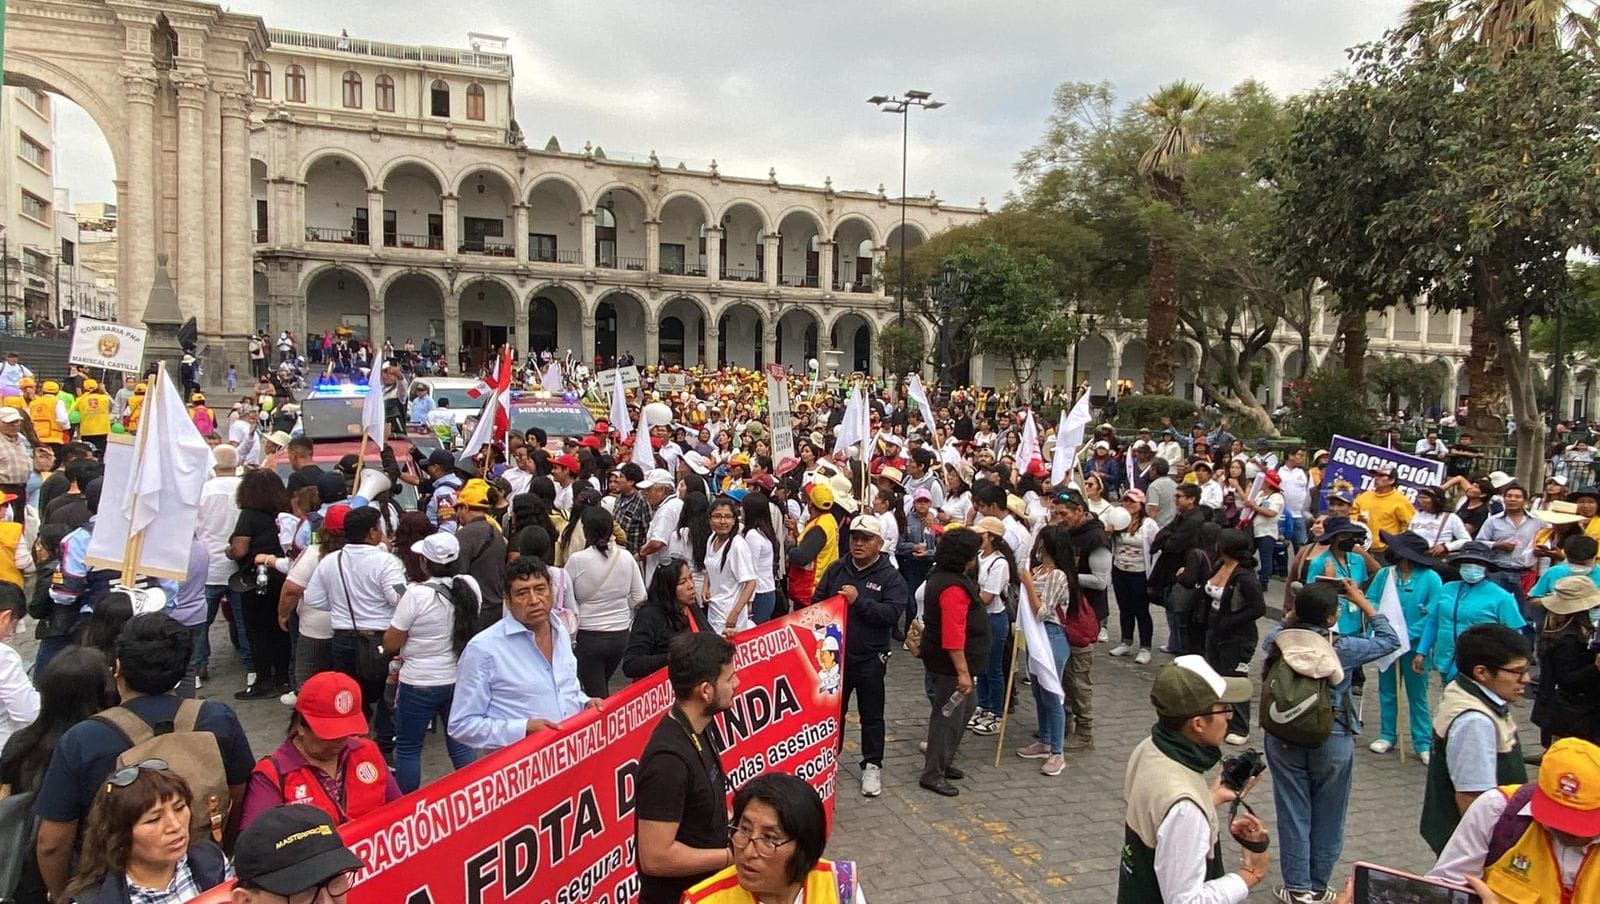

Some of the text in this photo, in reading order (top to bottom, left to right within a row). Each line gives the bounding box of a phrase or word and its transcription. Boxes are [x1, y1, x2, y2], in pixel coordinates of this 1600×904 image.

[80, 325, 124, 335] COMISARIA
[72, 356, 138, 371] MARISCAL CASTILLA
[1360, 474, 1418, 504] TAER
[347, 797, 452, 888] RACIÓN
[451, 721, 606, 831] DEPARTAMENTAL
[606, 706, 627, 746] DE
[733, 624, 799, 672] AREQUIPA
[464, 784, 606, 904] FDTA
[555, 845, 623, 904] segura
